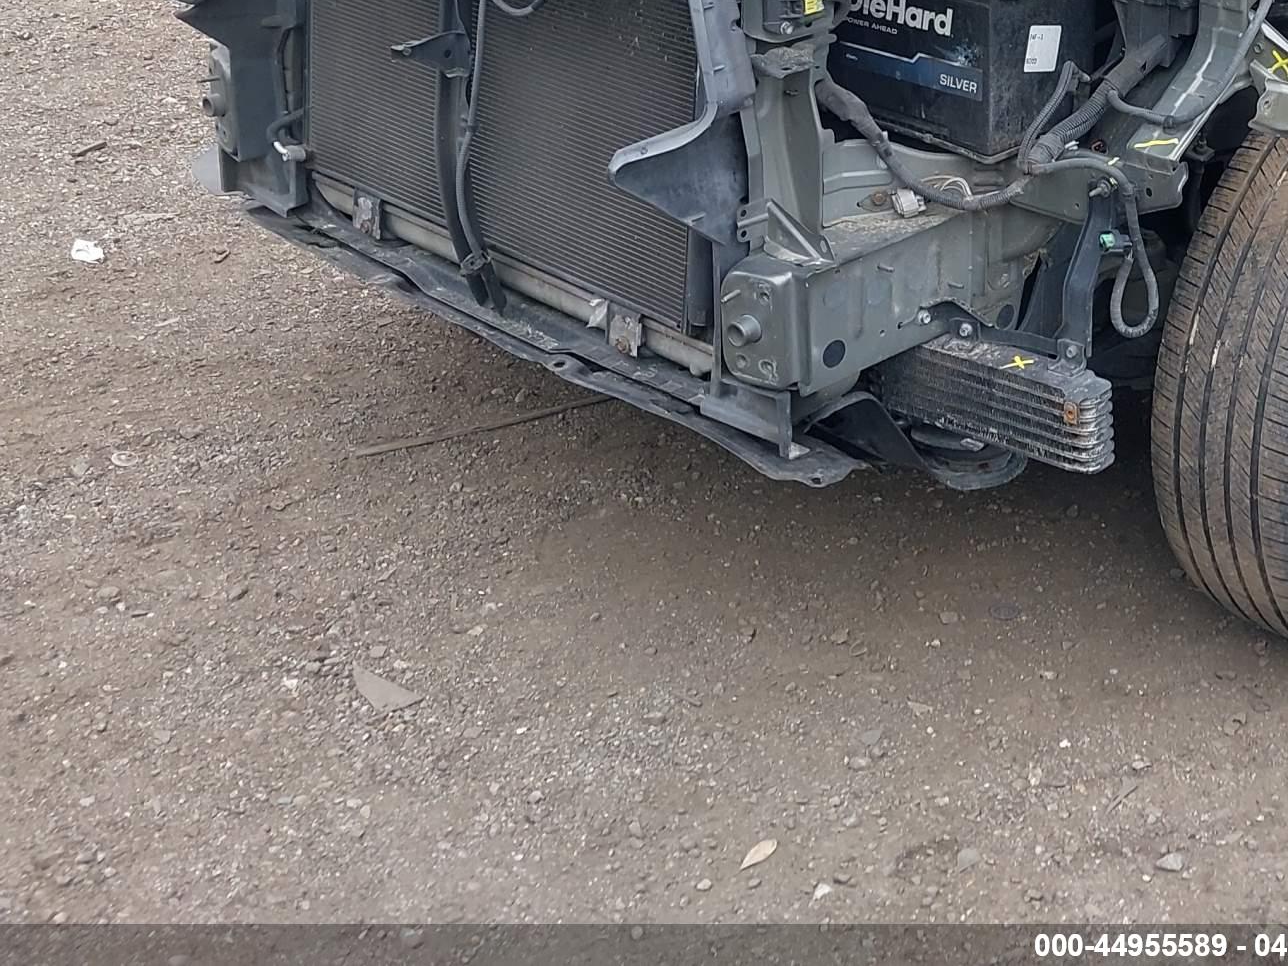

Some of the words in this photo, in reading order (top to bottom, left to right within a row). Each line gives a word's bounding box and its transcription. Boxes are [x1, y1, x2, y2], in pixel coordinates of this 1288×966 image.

[847, 17, 870, 28] OWER
[871, 22, 898, 35] AHEAD
[939, 73, 978, 94] SILVER
